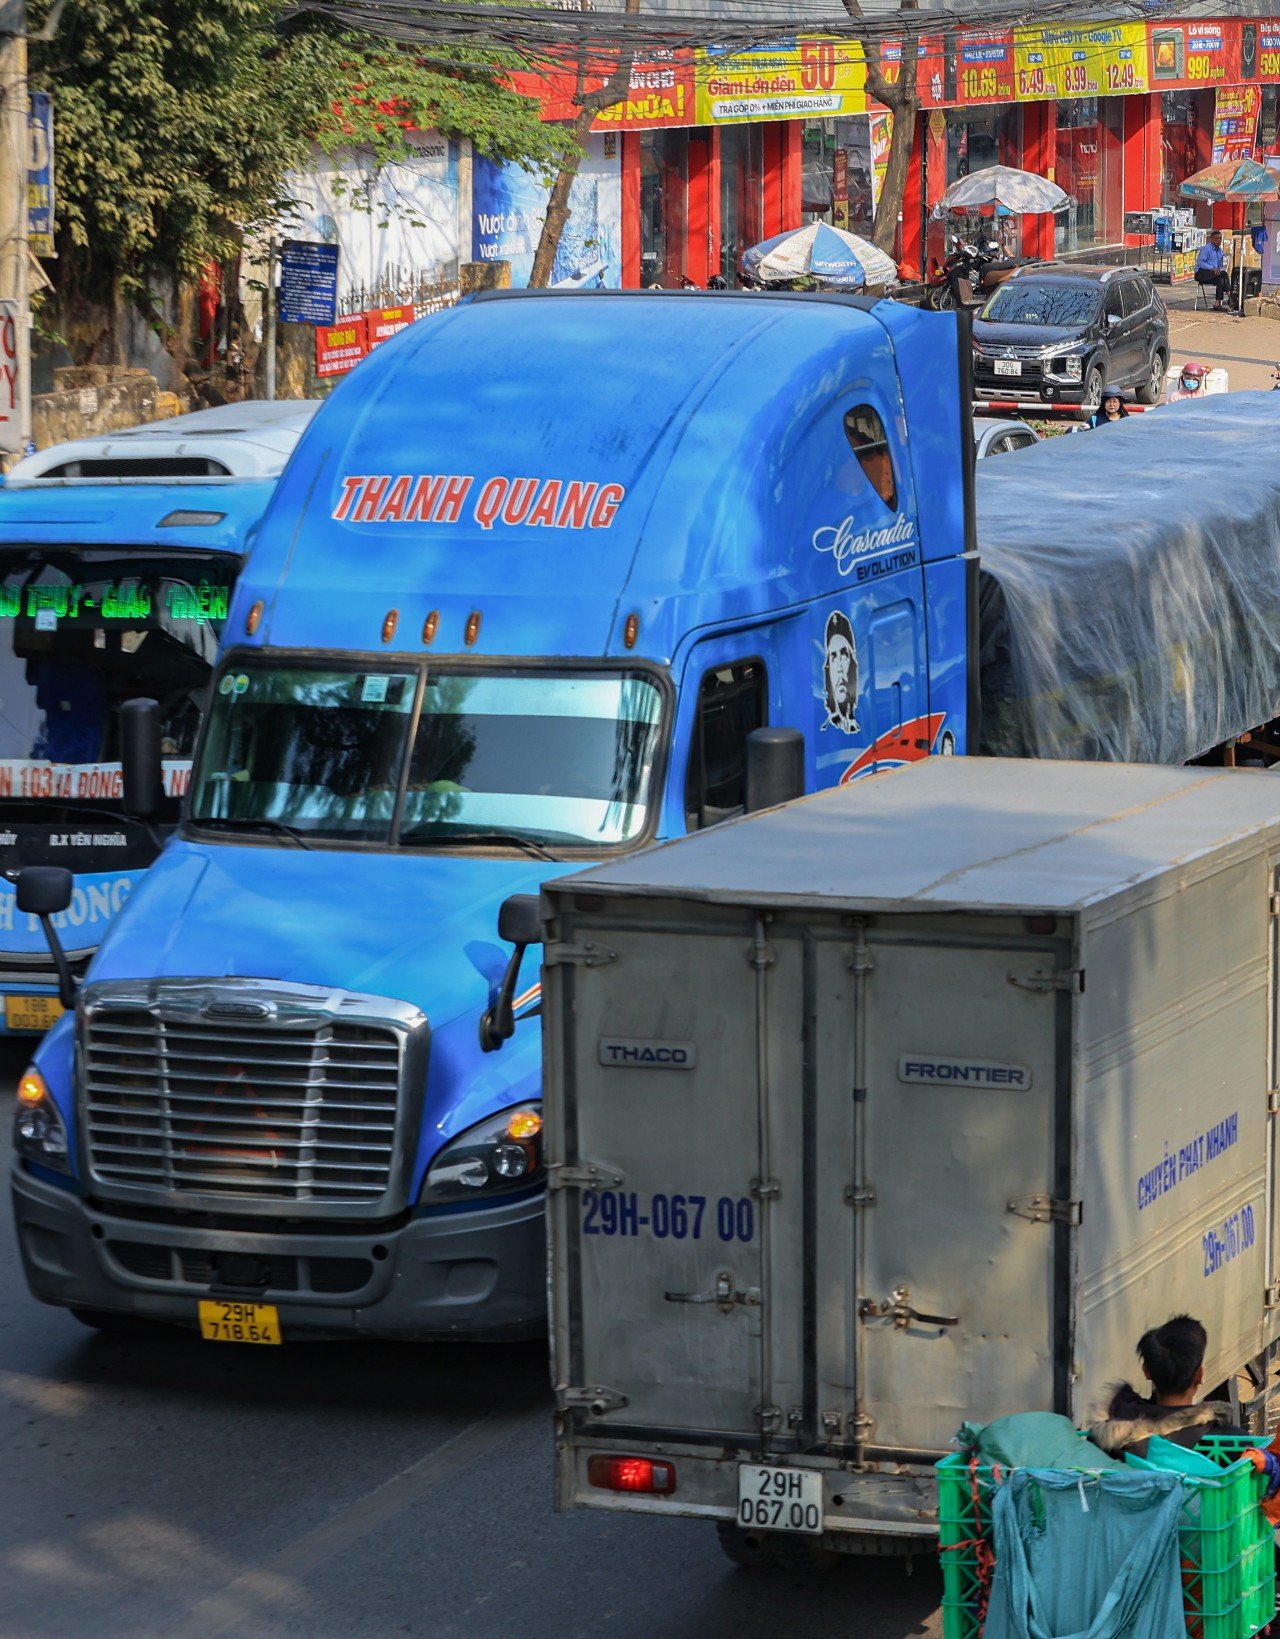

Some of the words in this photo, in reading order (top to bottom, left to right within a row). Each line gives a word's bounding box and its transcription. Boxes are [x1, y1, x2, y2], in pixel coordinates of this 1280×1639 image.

[800, 41, 836, 92] 50
[1065, 65, 1087, 91] 8.99
[1106, 63, 1134, 89] 12.49
[1188, 56, 1210, 80] 990
[707, 77, 744, 97] Giảm
[744, 75, 770, 95] Lớn
[771, 74, 797, 93] đến
[734, 101, 749, 114] GÓP
[331, 474, 474, 523] THANH
[474, 475, 626, 531] QUANG
[812, 512, 915, 576] Cascadia
[857, 550, 916, 581] EVOLUTION
[607, 1045, 688, 1065] THACO
[905, 1061, 1025, 1086] FRONTIER
[1178, 1129, 1205, 1182] PHÁT
[1206, 1111, 1239, 1164] NHANH
[582, 1191, 706, 1240] 29H-067
[717, 1197, 754, 1244] 00
[222, 1303, 256, 1323] 29H
[209, 1322, 271, 1342] 718.64
[757, 1468, 802, 1500] 29H
[740, 1497, 820, 1531] 067.00
